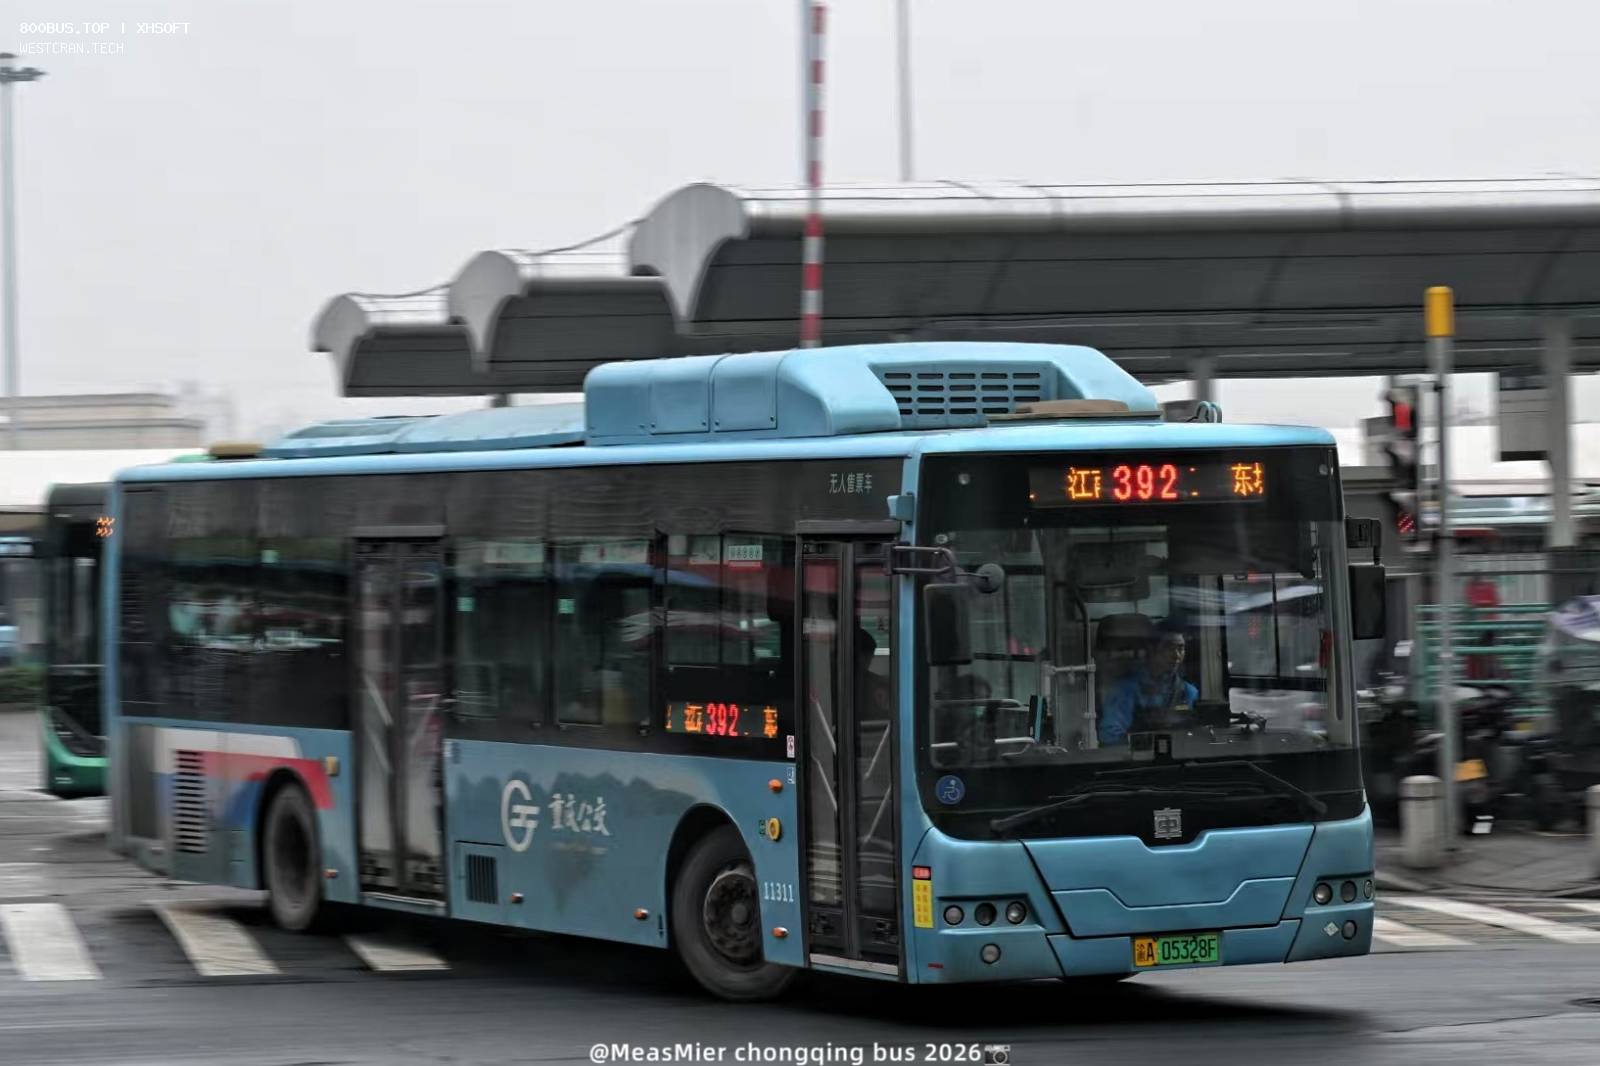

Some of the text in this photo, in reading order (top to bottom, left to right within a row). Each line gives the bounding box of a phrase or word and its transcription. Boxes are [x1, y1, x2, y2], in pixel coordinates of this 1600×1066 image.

[829, 472, 873, 494] 无人售票车
[1112, 464, 1179, 500] 392
[705, 703, 739, 737] 392
[763, 881, 795, 903] 11311
